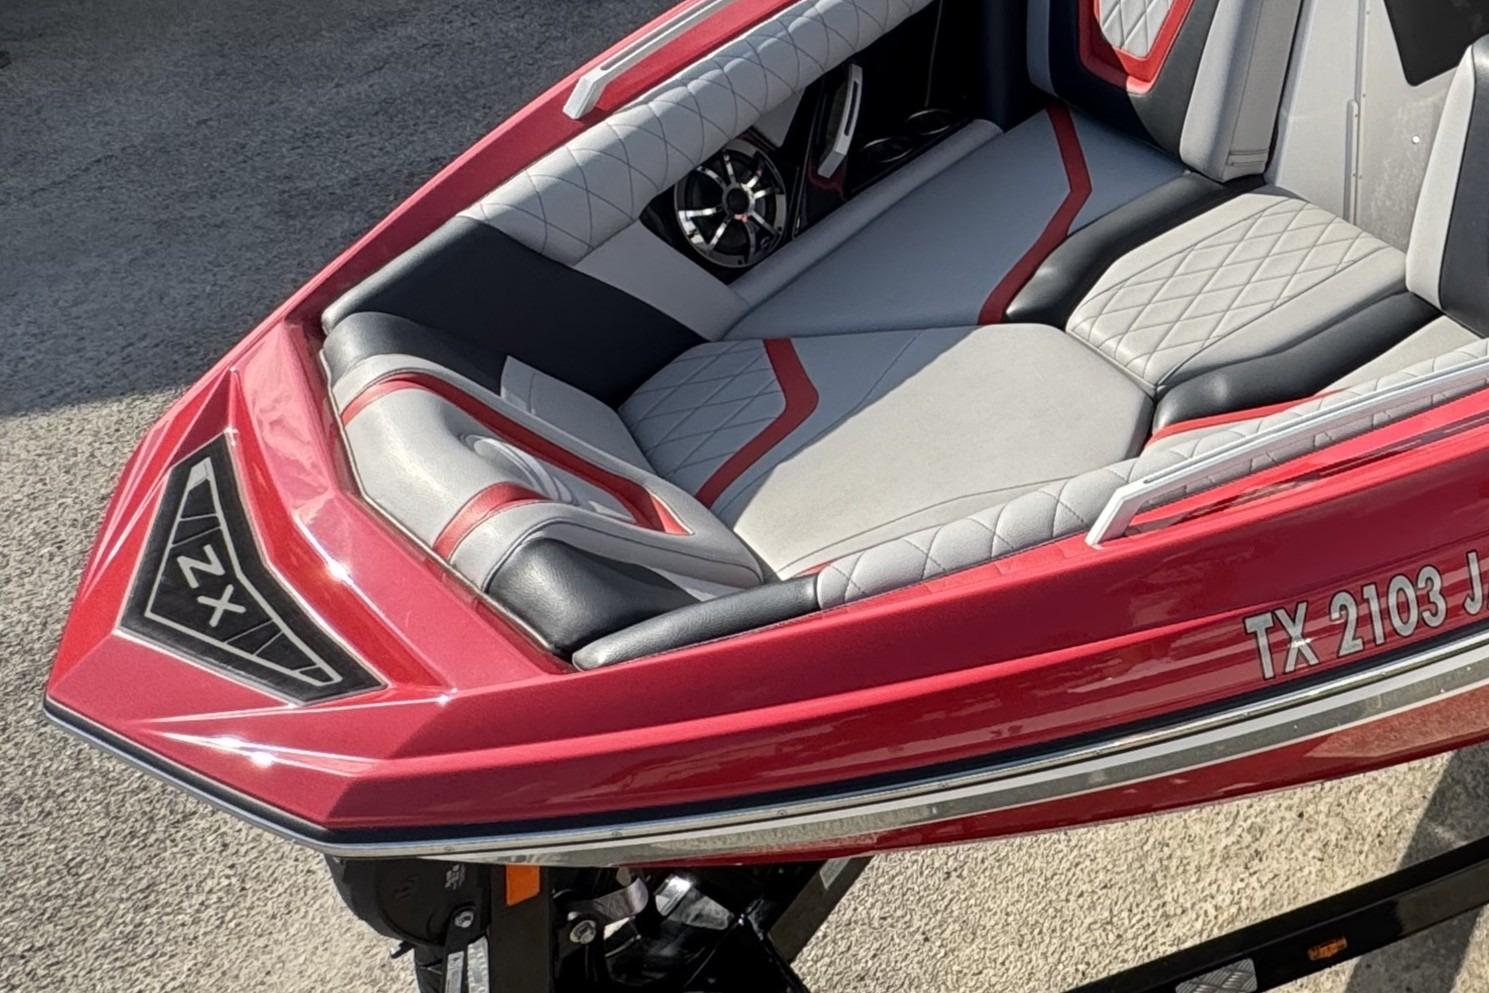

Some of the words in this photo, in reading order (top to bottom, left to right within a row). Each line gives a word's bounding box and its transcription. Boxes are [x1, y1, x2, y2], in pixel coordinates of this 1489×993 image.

[176, 543, 247, 628] ZX
[1244, 601, 1321, 681] TX
[1329, 564, 1447, 658] 2103
